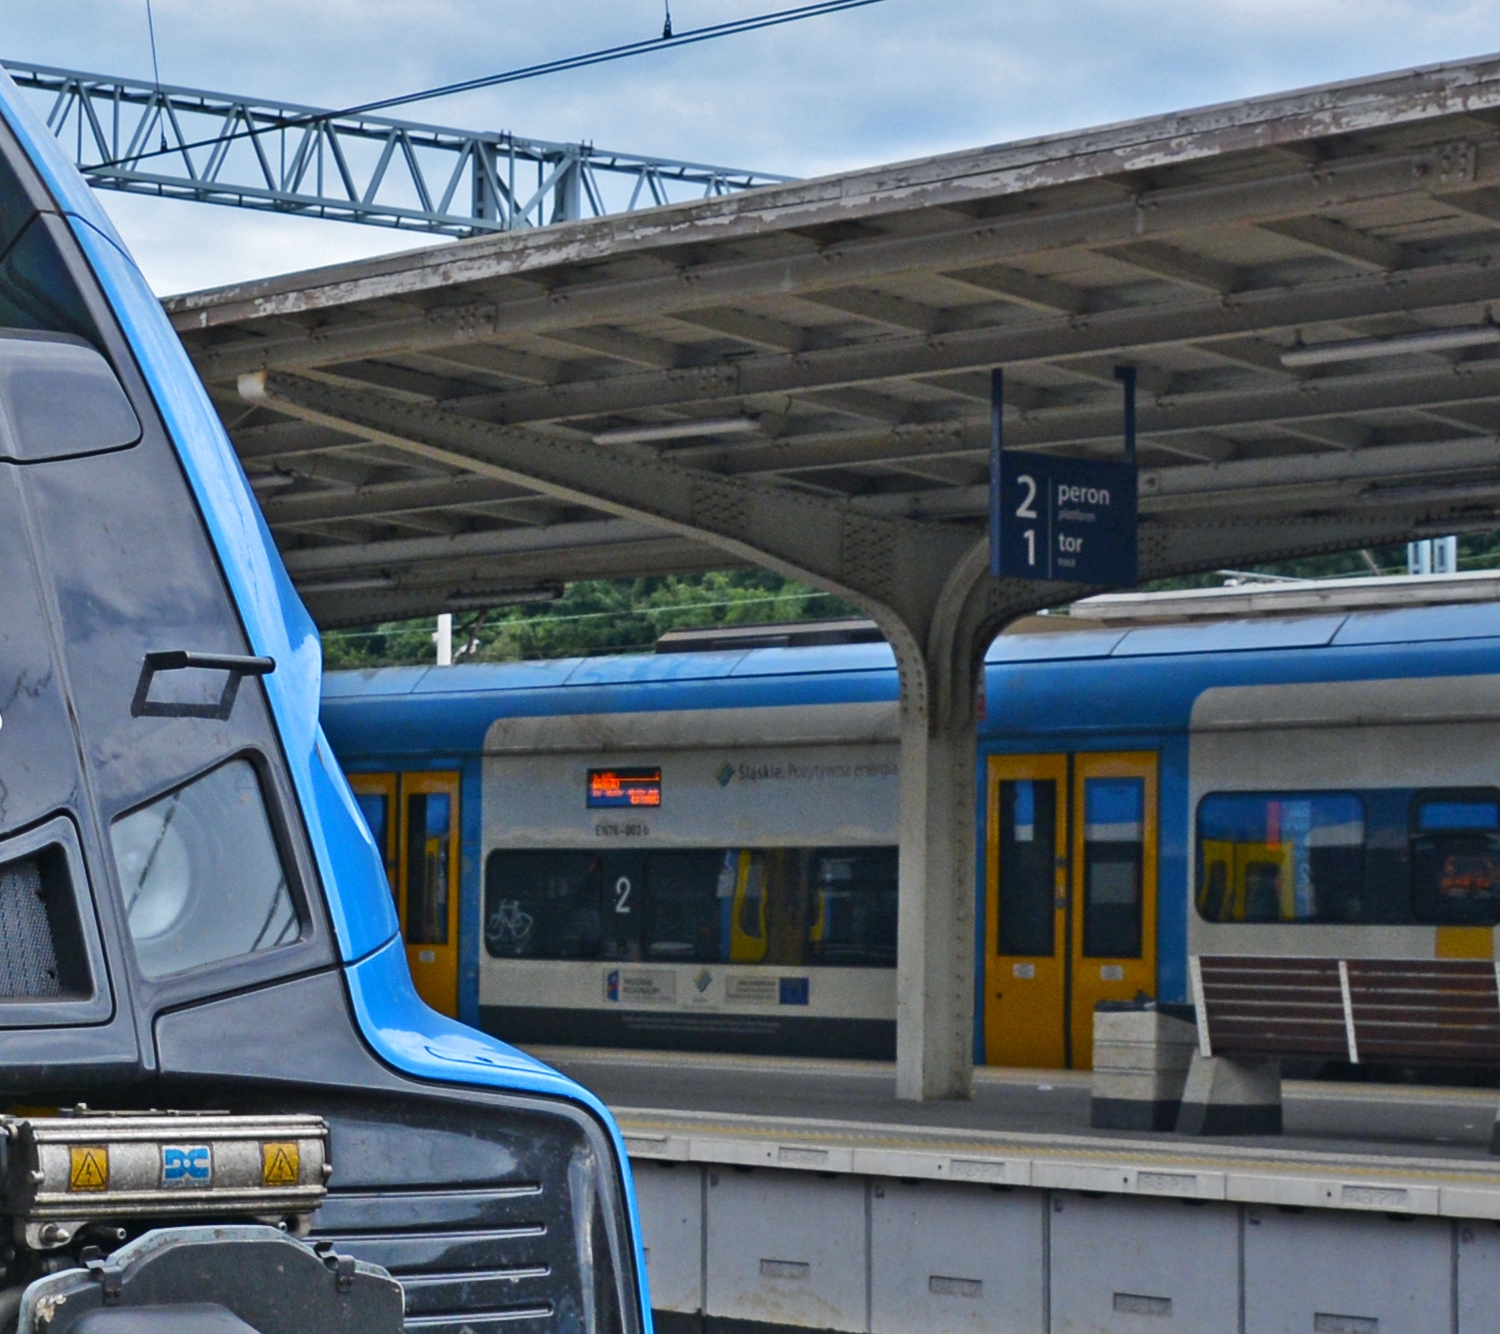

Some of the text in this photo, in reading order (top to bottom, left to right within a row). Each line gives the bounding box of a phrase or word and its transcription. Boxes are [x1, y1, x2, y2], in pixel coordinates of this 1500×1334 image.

[1015, 474, 1111, 519] 2 peron
[1023, 529, 1084, 566] 1 tor
[614, 875, 632, 914] 2
